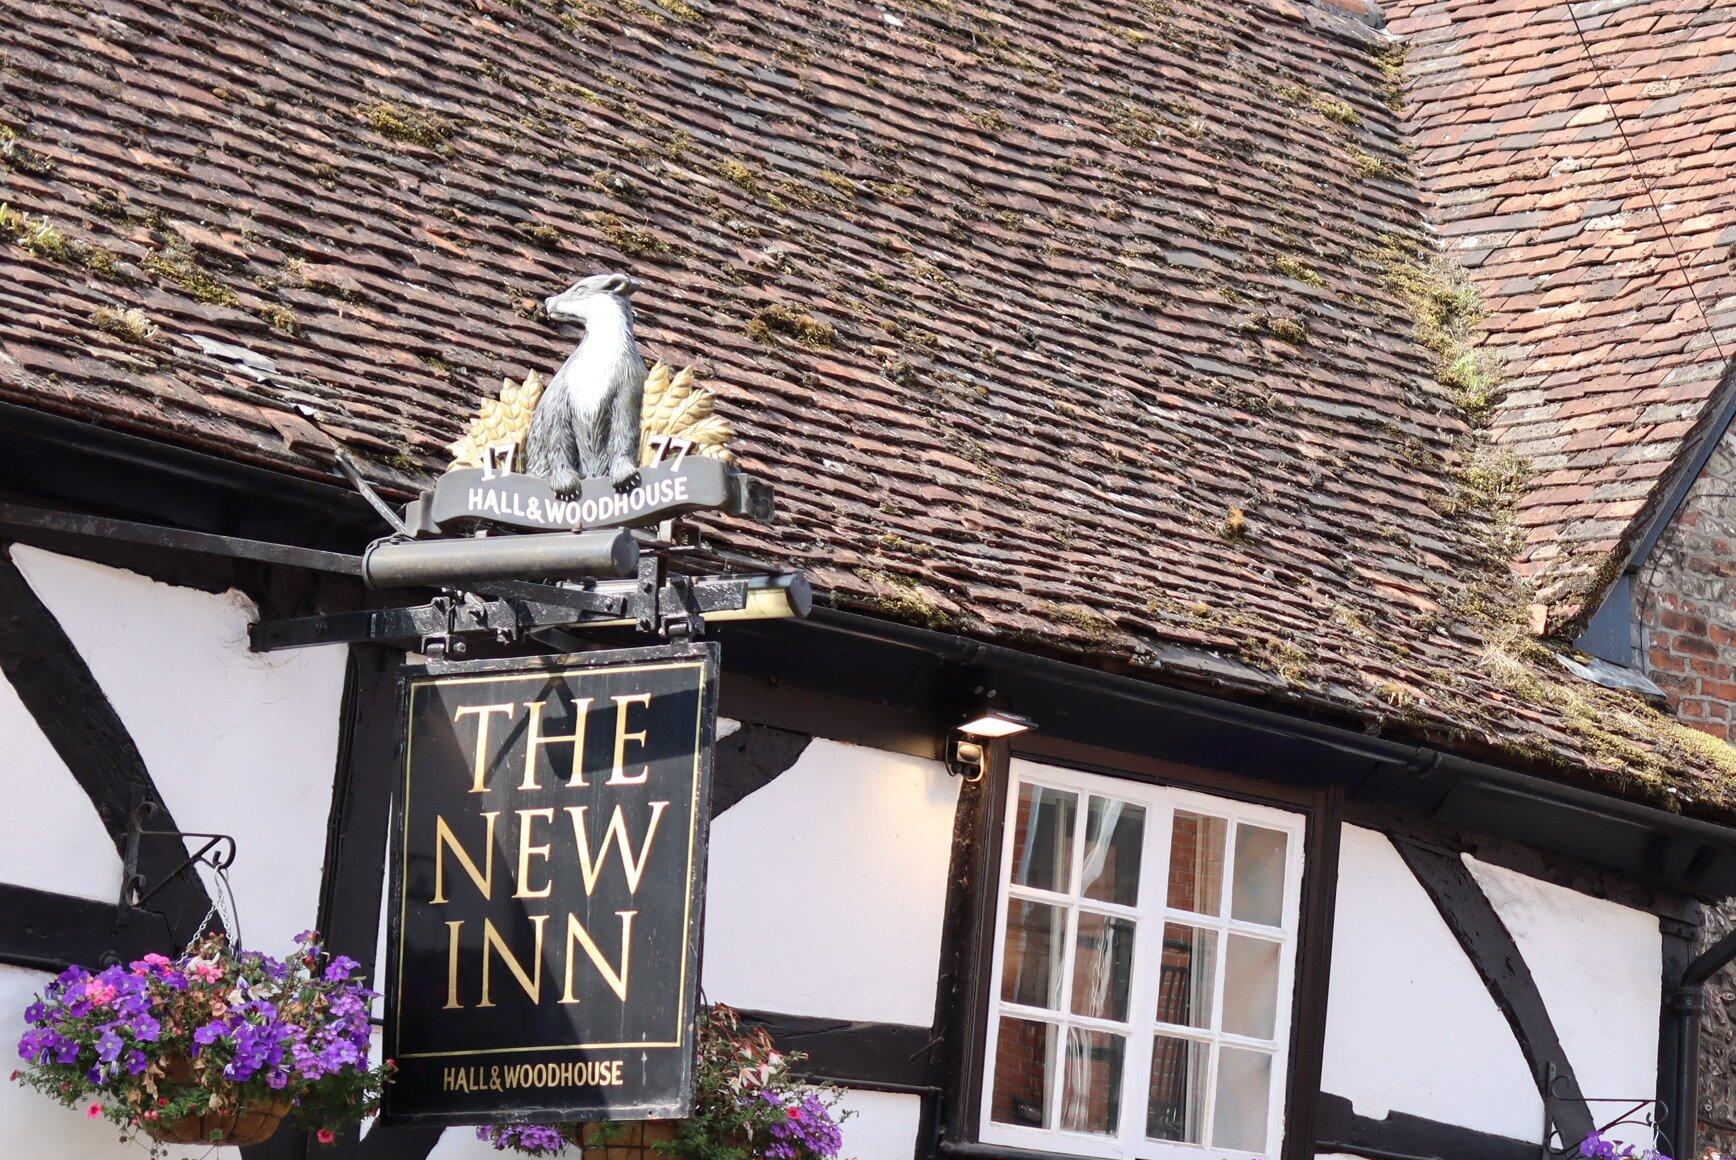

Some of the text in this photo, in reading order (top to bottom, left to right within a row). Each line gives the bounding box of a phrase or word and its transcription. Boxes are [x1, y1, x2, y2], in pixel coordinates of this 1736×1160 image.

[480, 435, 695, 482] 17 77
[454, 694, 651, 794] THE
[428, 801, 670, 905] NEW
[442, 911, 637, 1010] INN
